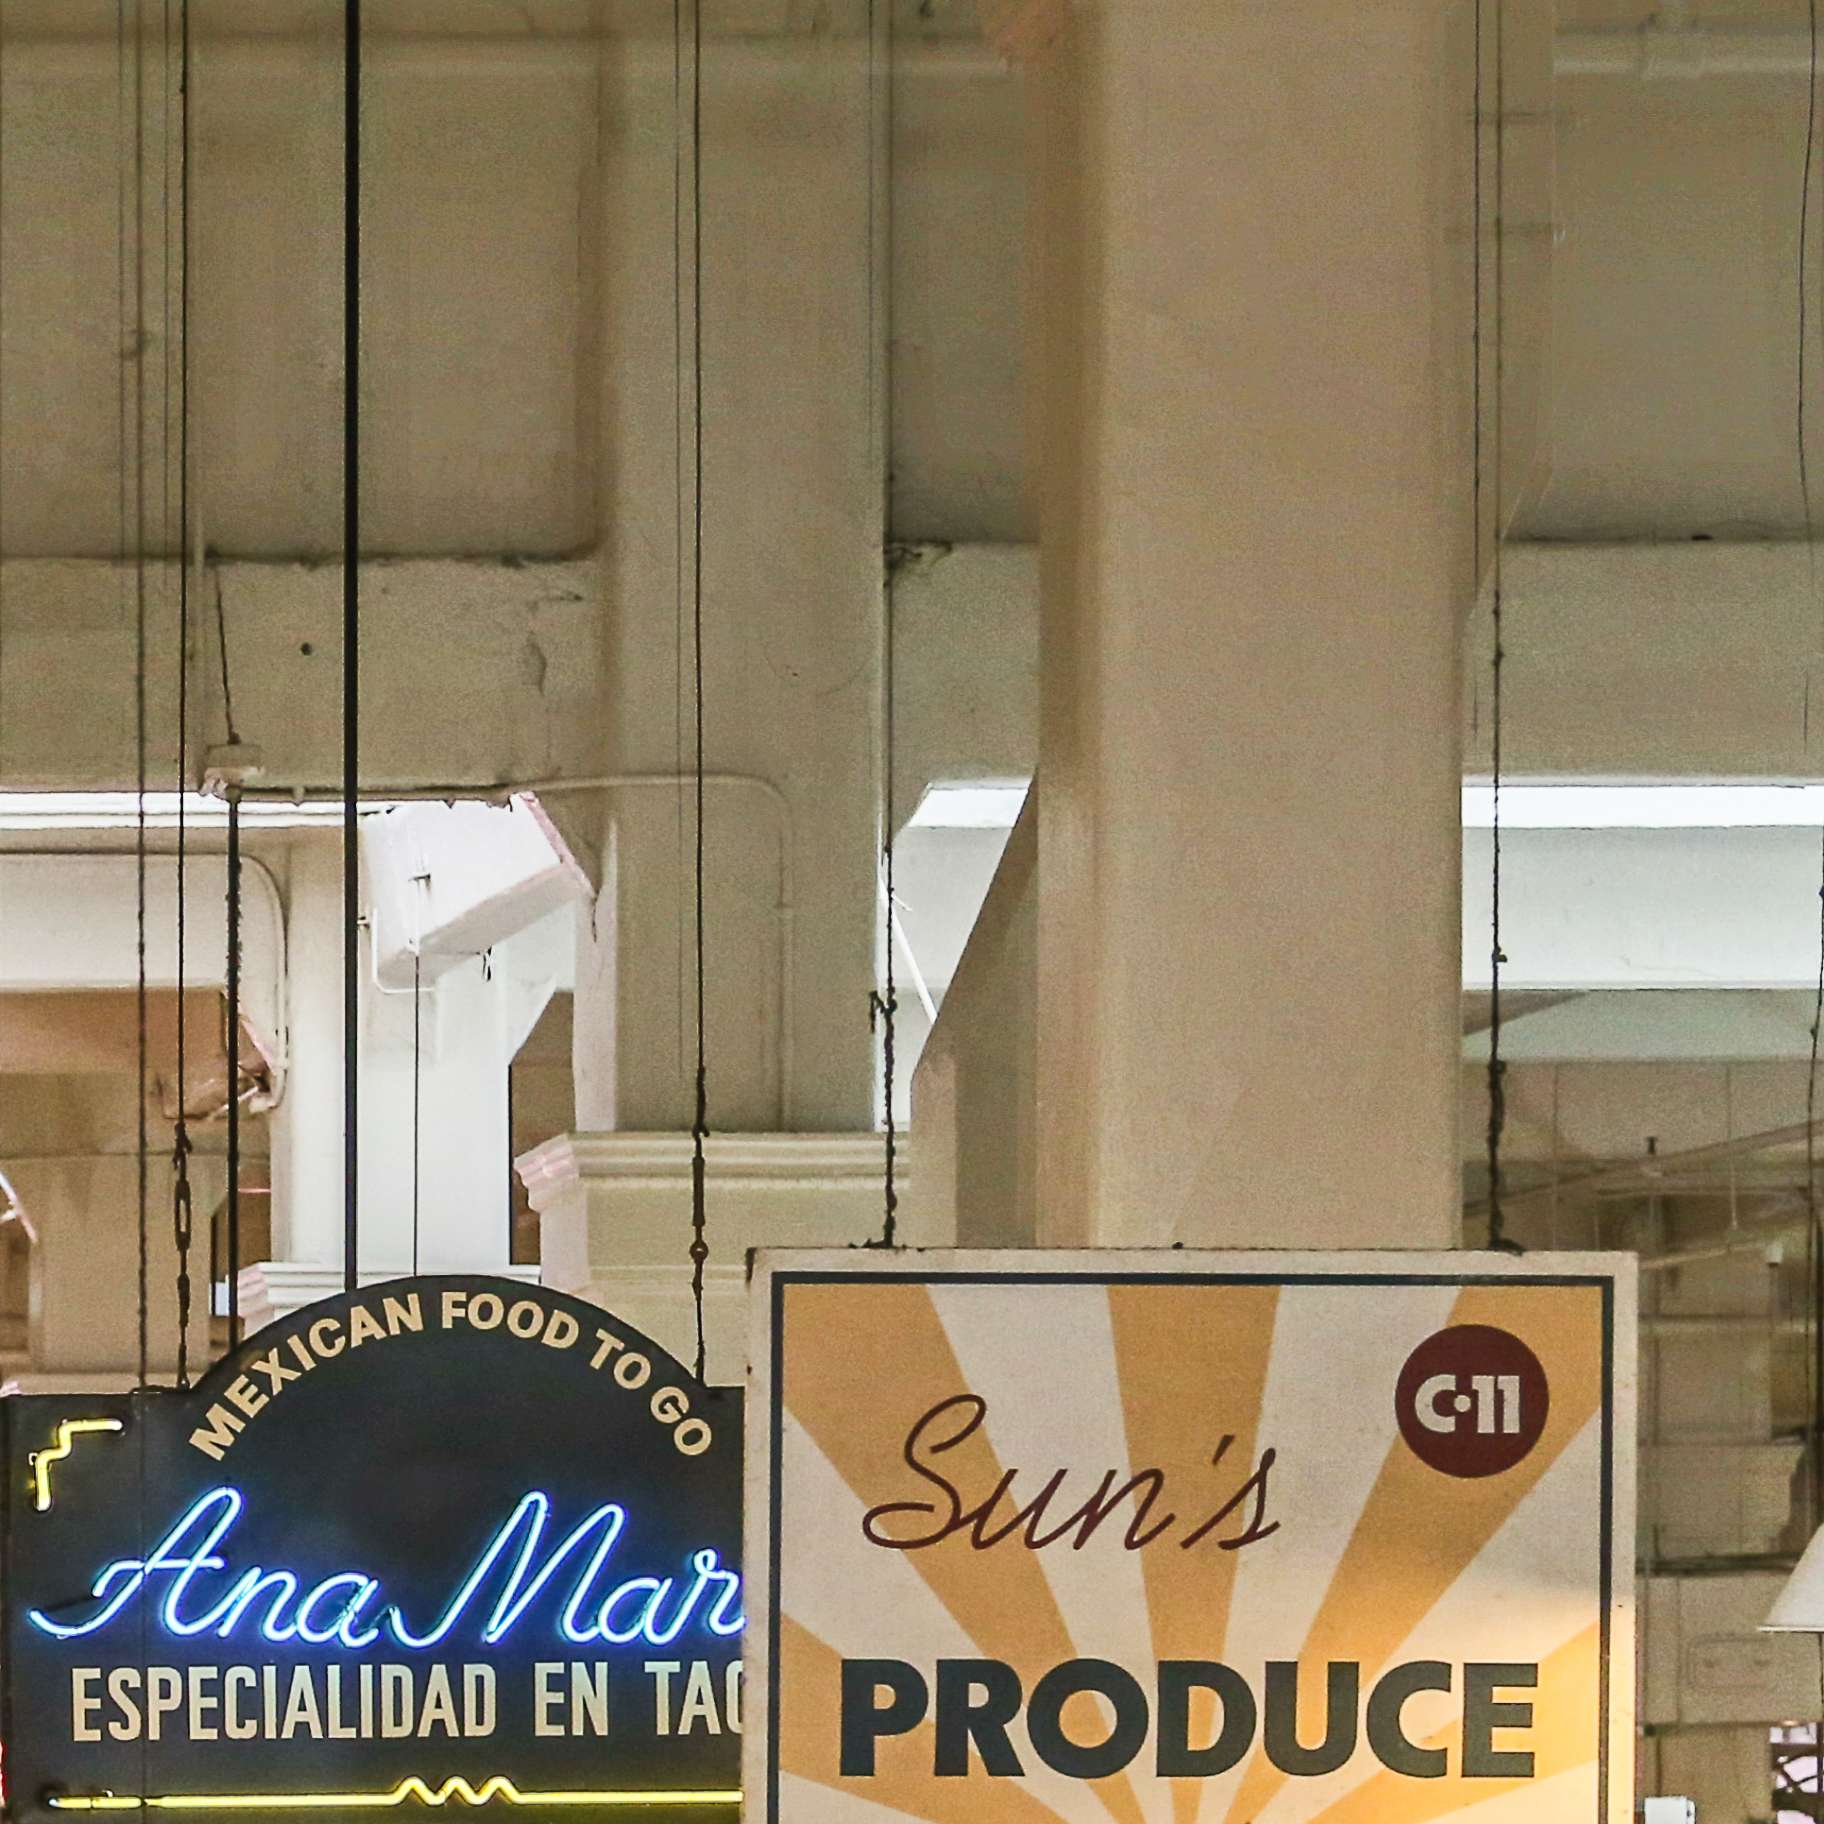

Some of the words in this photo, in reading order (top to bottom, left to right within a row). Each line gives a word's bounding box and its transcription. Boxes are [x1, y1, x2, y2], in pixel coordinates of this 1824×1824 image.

[188, 1292, 424, 1461] MEXICAN
[441, 1290, 582, 1350] FOOD
[590, 1328, 651, 1390] TO
[650, 1386, 714, 1457] GO
[861, 1393, 1282, 1552] Sun's
[28, 1486, 382, 1641] Ana
[71, 1662, 498, 1743] ESPECIALIDAD
[534, 1662, 609, 1737] EN
[838, 1657, 1540, 1780] PRODUCE
